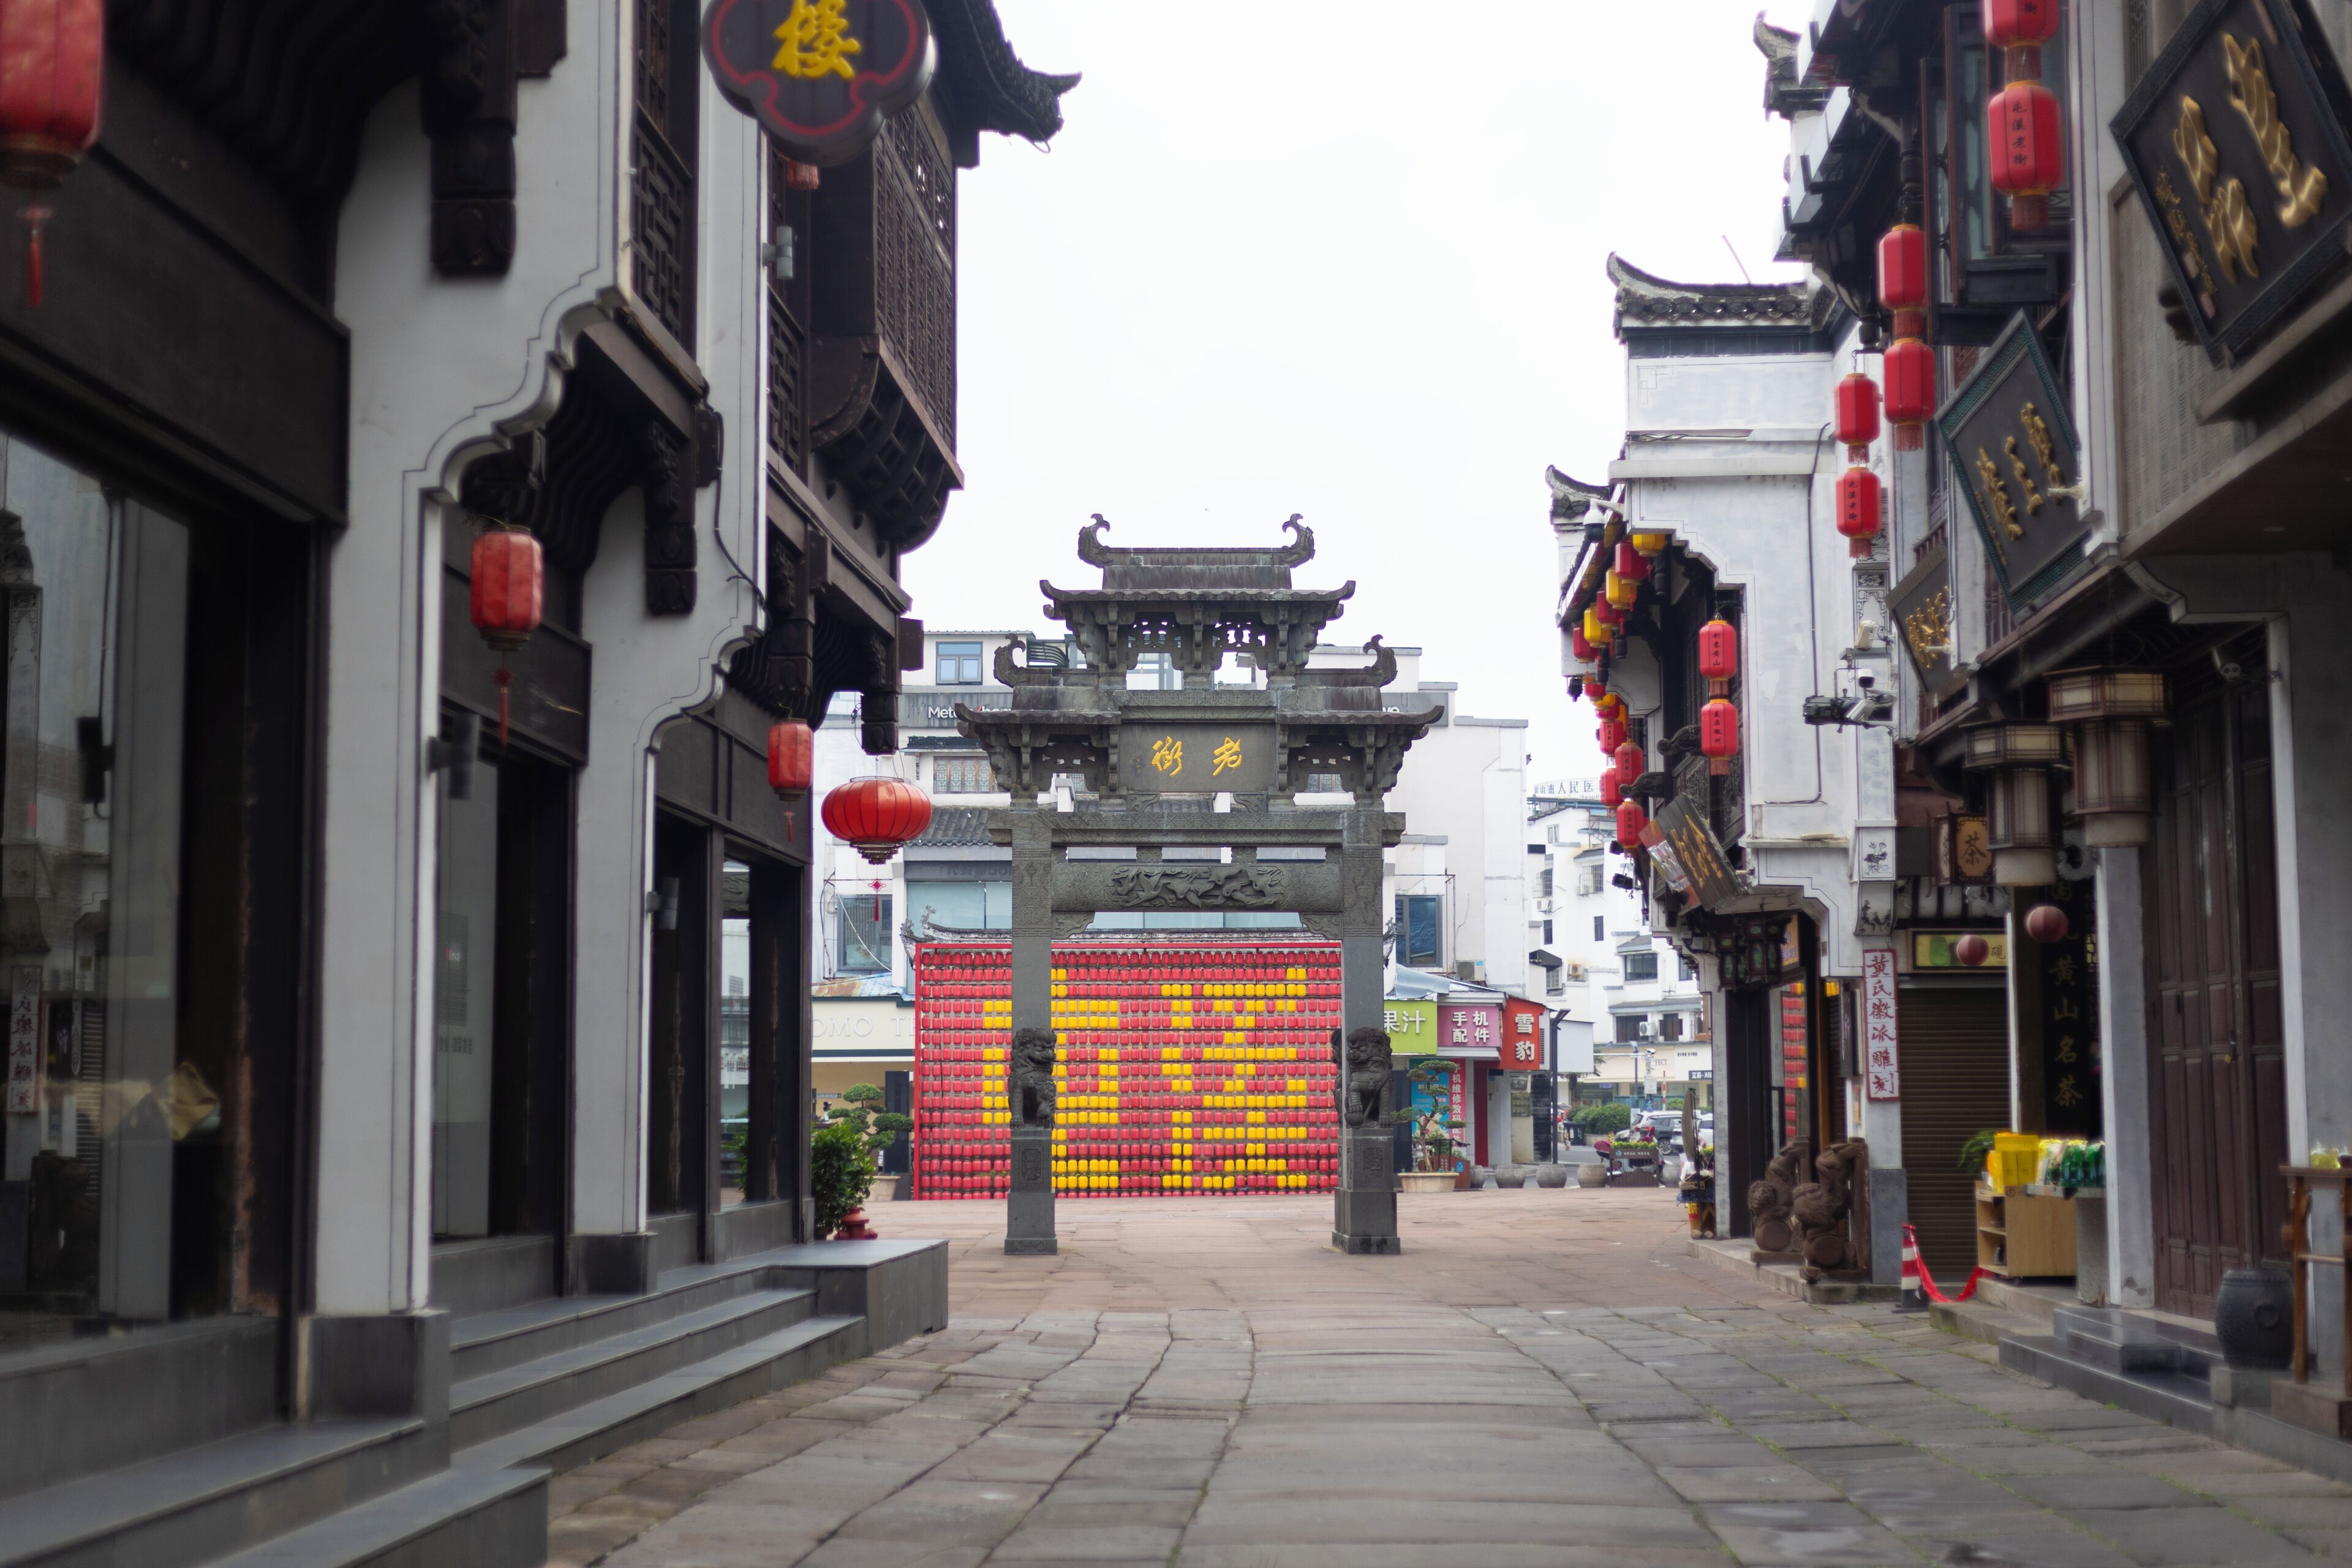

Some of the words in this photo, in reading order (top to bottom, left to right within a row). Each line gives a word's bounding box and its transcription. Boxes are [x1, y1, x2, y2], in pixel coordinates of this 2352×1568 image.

[1960, 831, 1988, 867] 茶
[1384, 1009, 1426, 1034] 果汁
[1452, 1011, 1489, 1027] 手机
[1866, 953, 1897, 1095] 黄氏徽派雕刻
[1452, 1027, 1490, 1044] 配件
[1515, 1013, 1535, 1061] 雪豹
